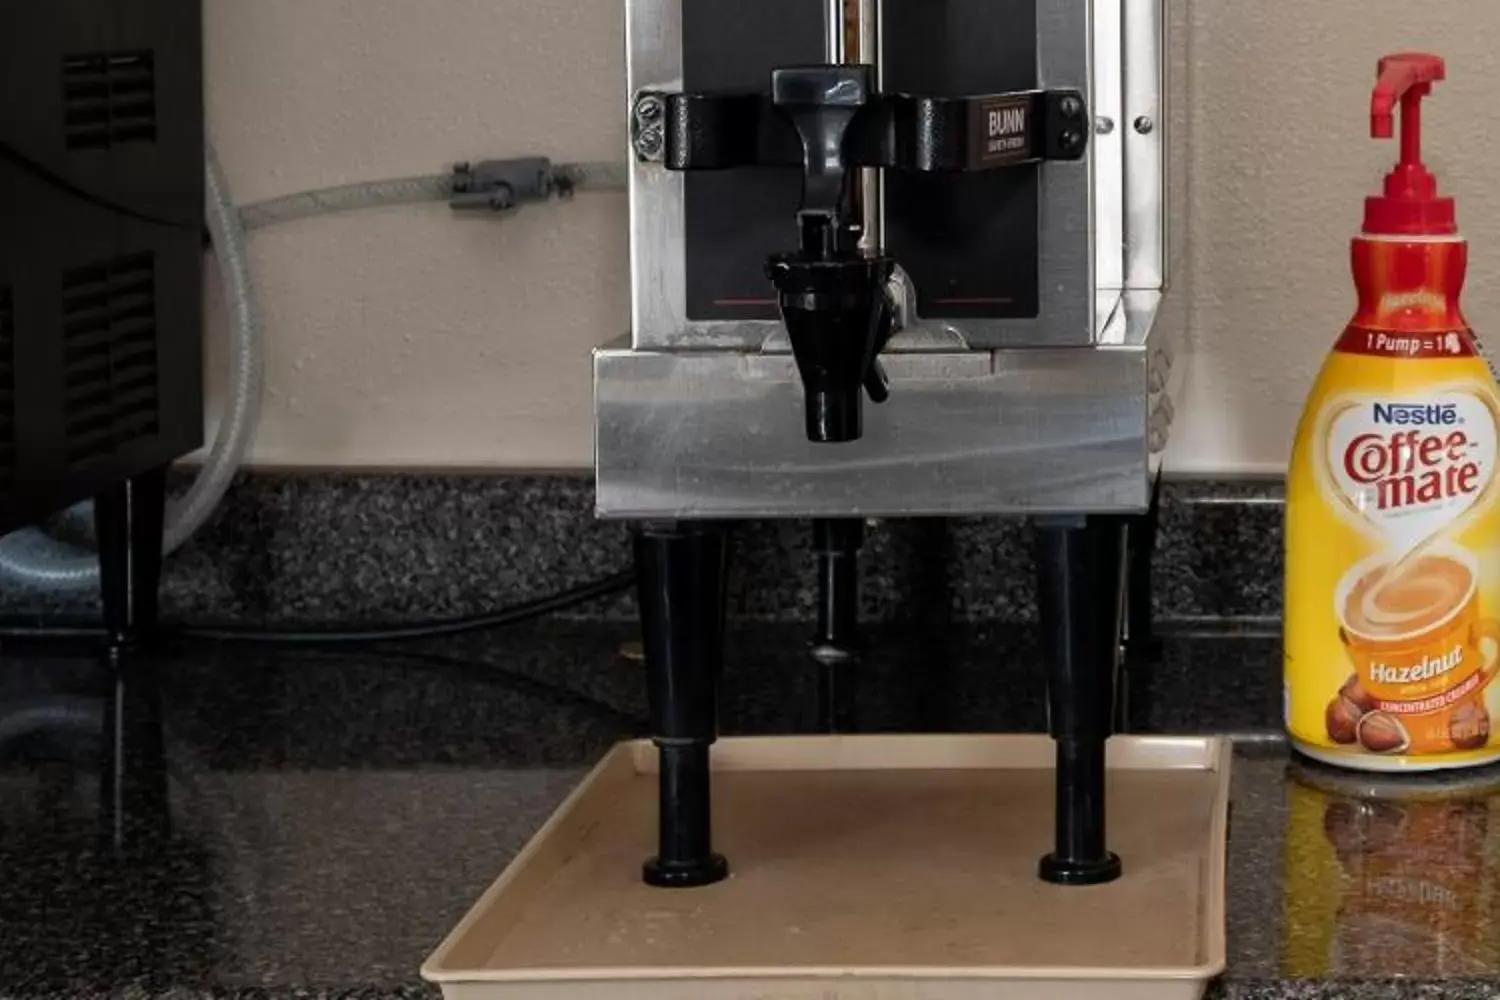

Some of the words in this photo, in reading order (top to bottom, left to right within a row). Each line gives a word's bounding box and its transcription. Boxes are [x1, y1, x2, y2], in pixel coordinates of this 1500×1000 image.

[988, 107, 1025, 137] BUNN
[1376, 333, 1421, 356] Pump
[1376, 462, 1479, 510] mate
[1369, 645, 1463, 684] Hazelnut
